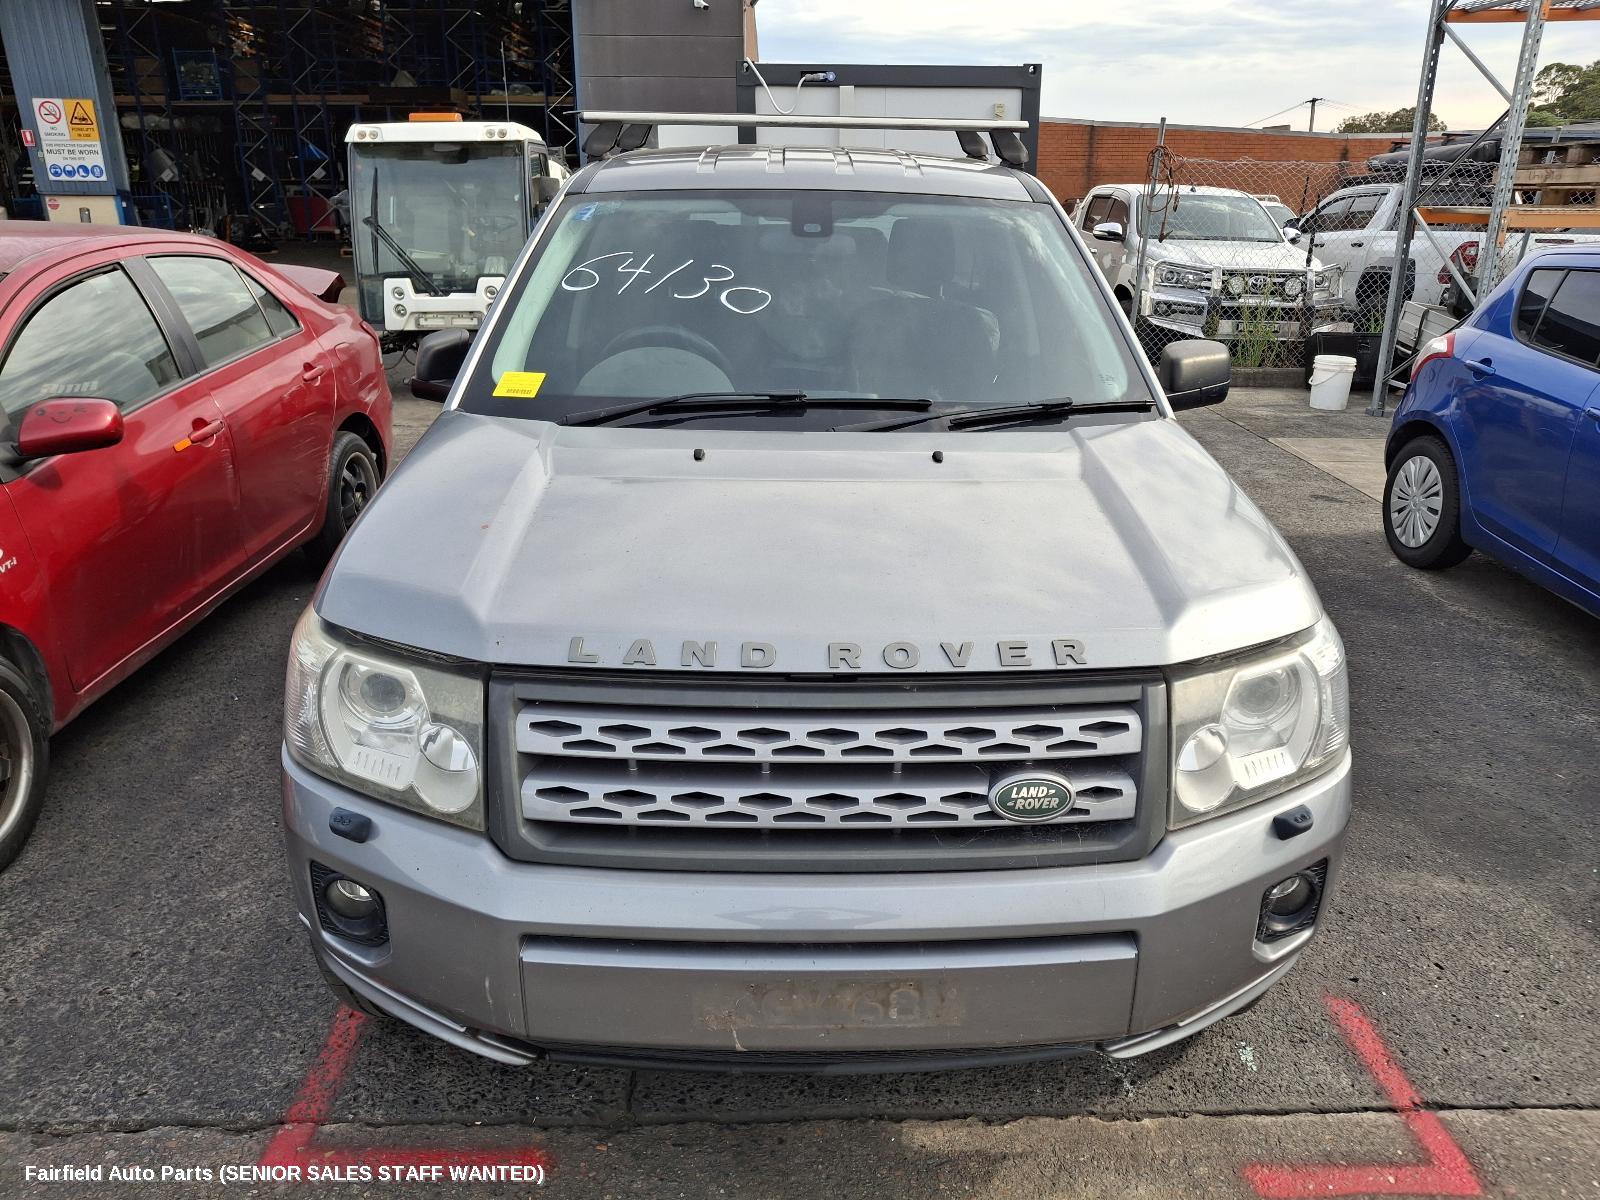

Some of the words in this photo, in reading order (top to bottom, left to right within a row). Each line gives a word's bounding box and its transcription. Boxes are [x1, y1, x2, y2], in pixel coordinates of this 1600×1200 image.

[561, 251, 772, 314] 64130
[567, 636, 777, 669] LAND
[827, 638, 1089, 670] ROVER
